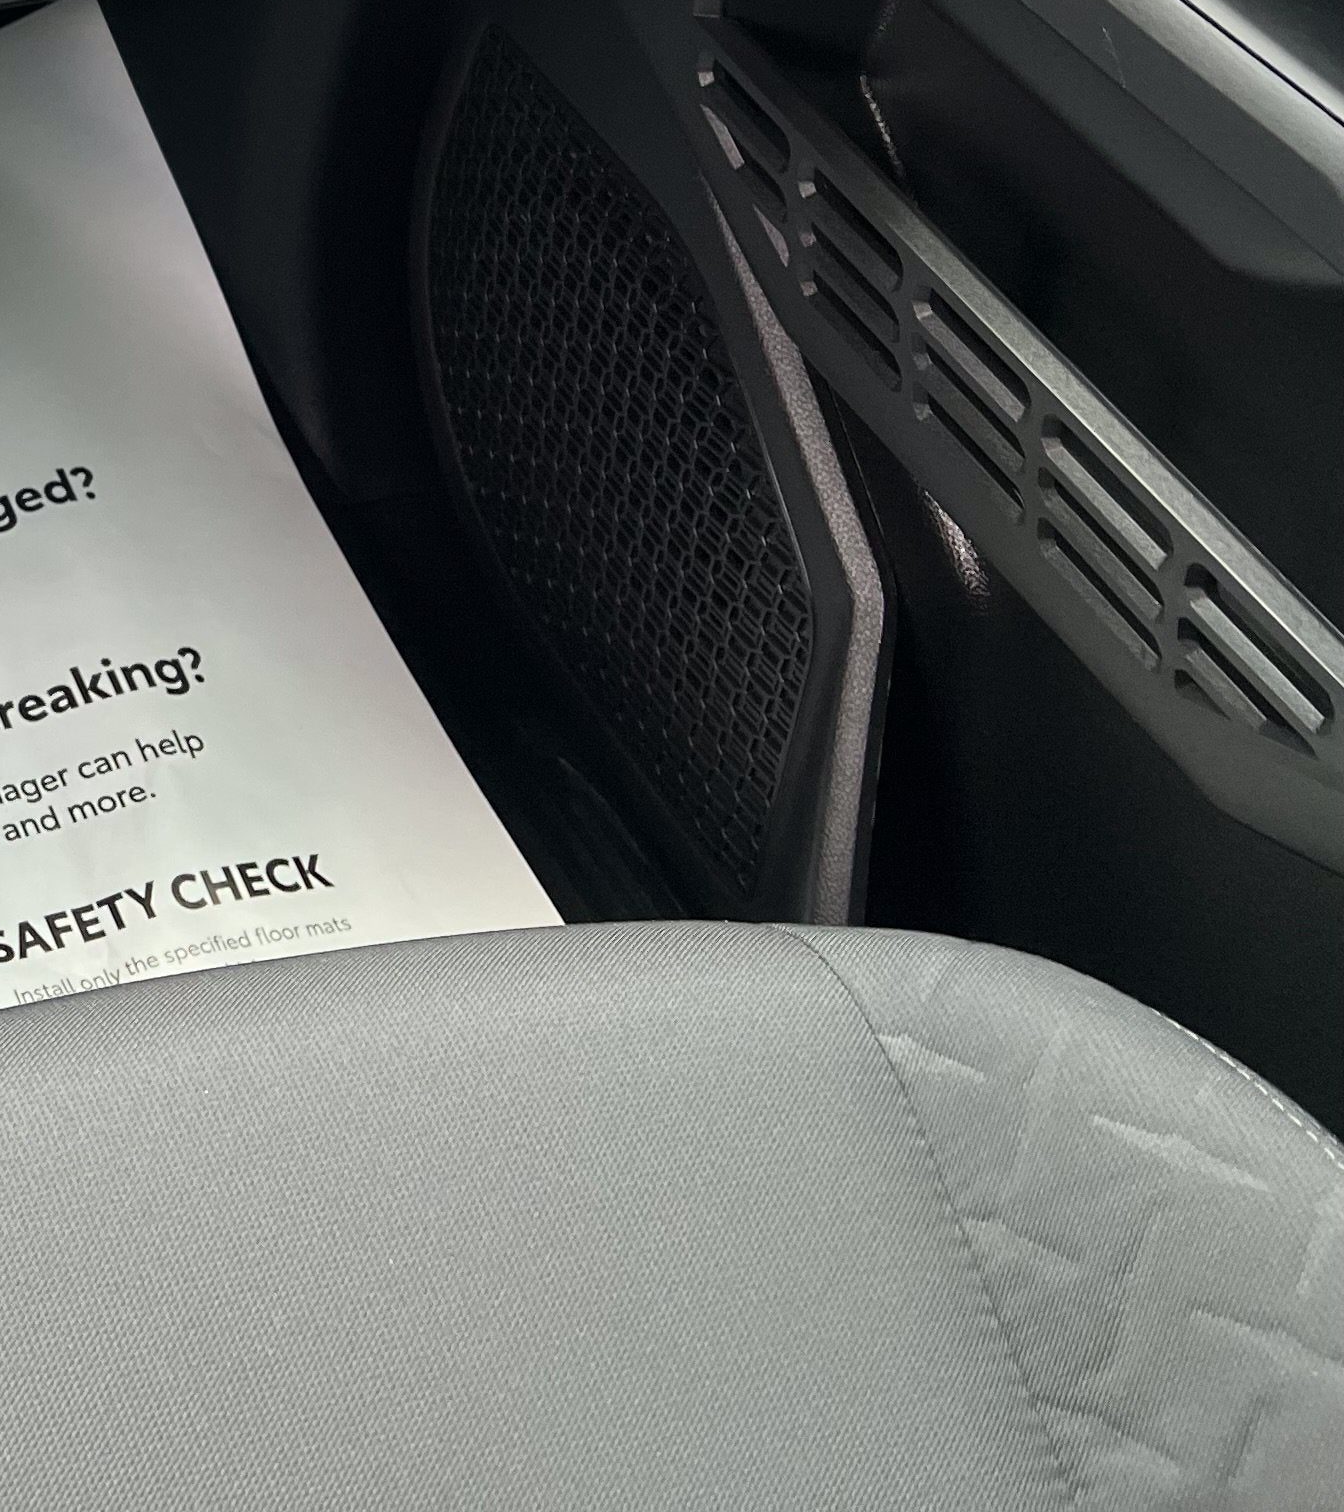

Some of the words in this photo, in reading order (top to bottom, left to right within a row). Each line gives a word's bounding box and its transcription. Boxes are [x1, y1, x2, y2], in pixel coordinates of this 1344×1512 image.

[77, 749, 133, 782] can
[136, 728, 204, 765] help
[3, 808, 62, 842] and
[67, 787, 157, 823] more.
[170, 853, 335, 912] CHECK
[14, 976, 77, 1006] Install
[80, 968, 121, 992] only
[125, 952, 161, 977] the
[163, 931, 253, 965] specified
[255, 926, 302, 947] floor
[306, 916, 353, 937] mats
